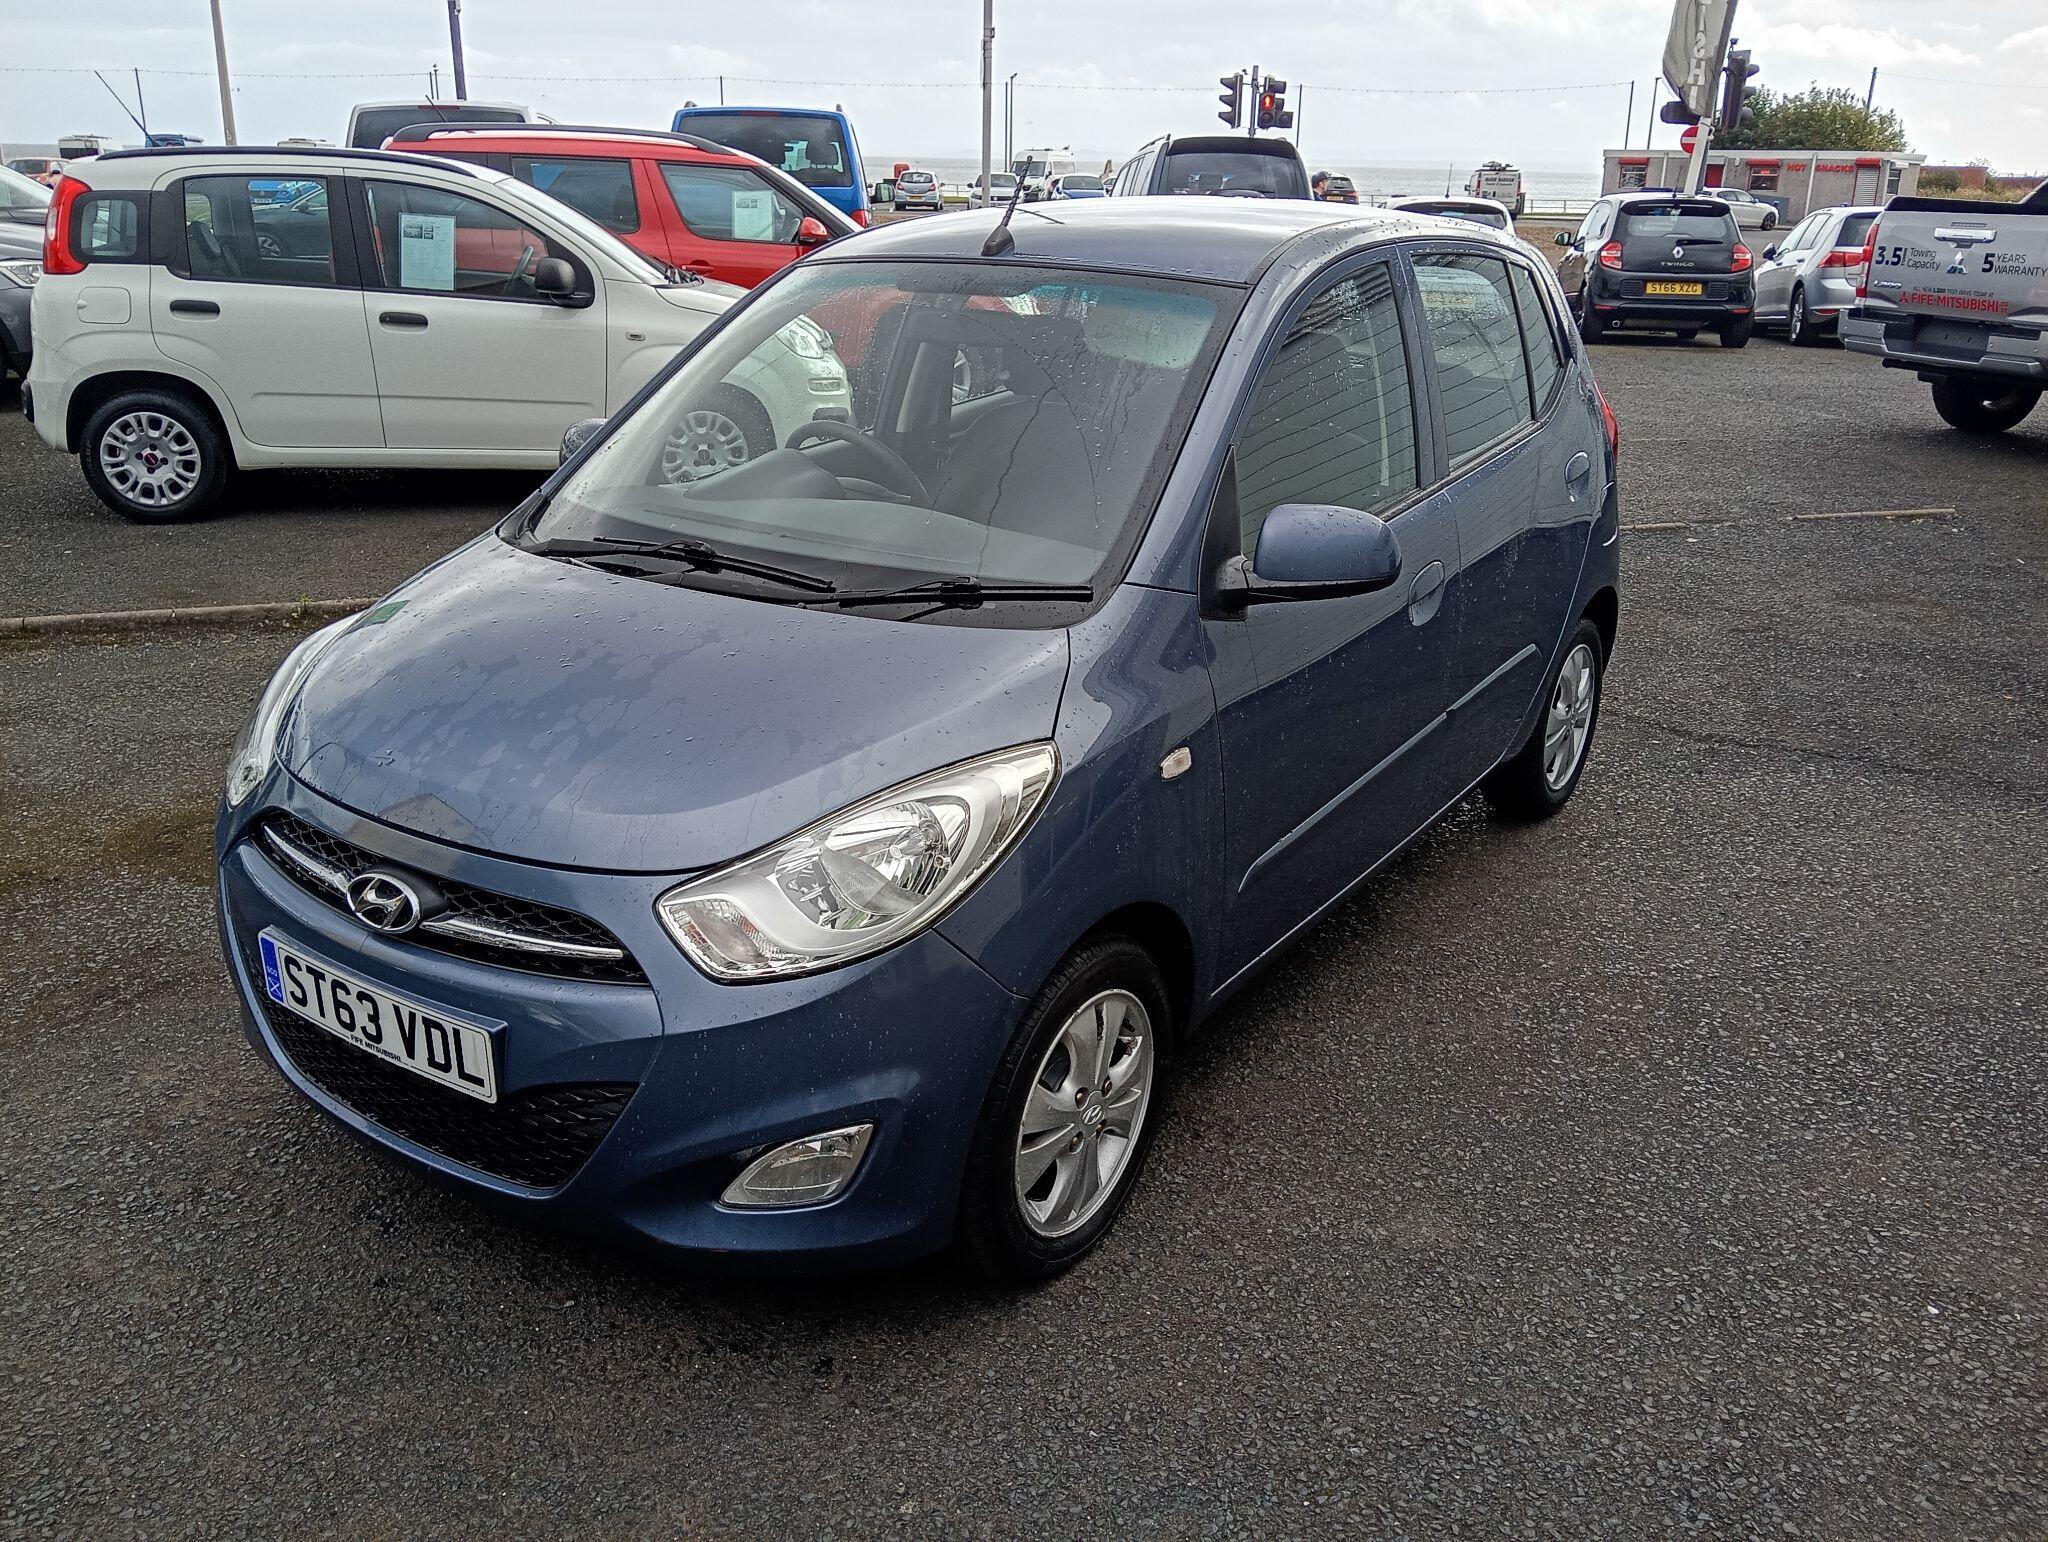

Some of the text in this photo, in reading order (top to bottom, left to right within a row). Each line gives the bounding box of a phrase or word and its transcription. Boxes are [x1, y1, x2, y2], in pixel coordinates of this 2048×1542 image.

[1786, 163, 1854, 172] HOT SNACKS
[1875, 246, 1903, 266] 3.5
[1910, 248, 1937, 259] Towing
[1997, 253, 2027, 264] YEARS
[1907, 259, 1941, 271] Capacity
[1982, 252, 1996, 273] 5
[1994, 265, 2048, 277] WARRANTY
[1651, 283, 1698, 293] ST66 XZG
[1911, 293, 1934, 305] FIFE
[1936, 295, 1999, 312] MITSUBISHI
[284, 955, 485, 1088] ST63 VDL
[350, 1034, 402, 1062] FIFE MITSUBISHI
